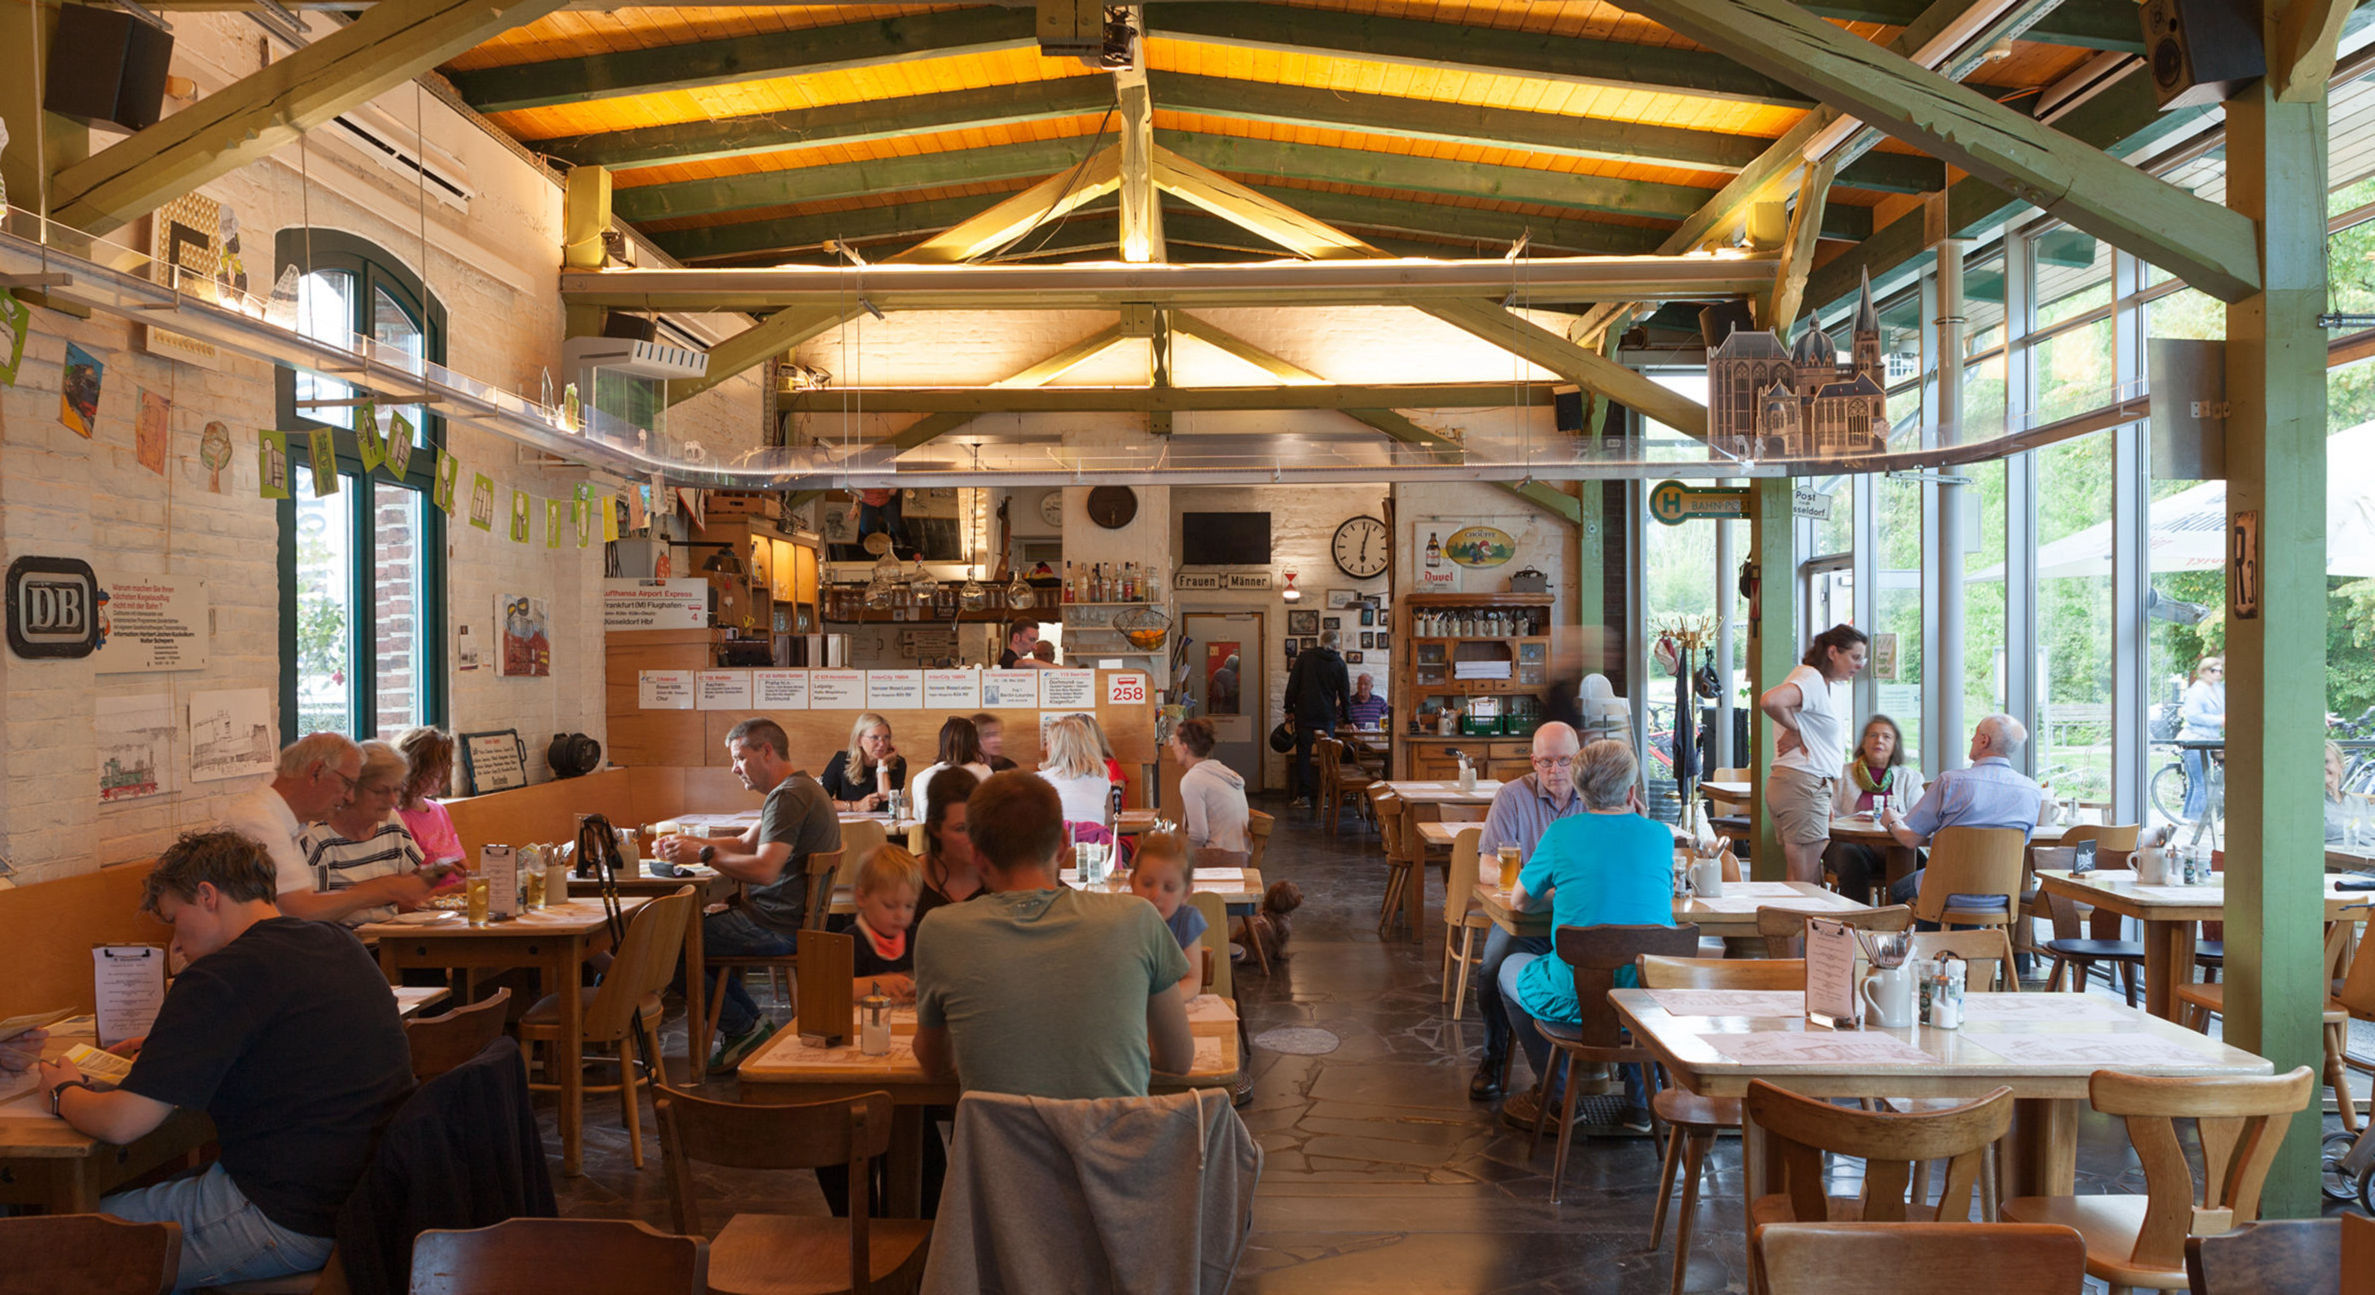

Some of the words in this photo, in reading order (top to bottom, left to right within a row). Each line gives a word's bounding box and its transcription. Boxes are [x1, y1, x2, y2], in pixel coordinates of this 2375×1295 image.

[1796, 491, 1815, 501] Post
[1663, 493, 1680, 513] H
[1793, 506, 1825, 517] sseldorf
[1180, 576, 1215, 586] Frauen
[1231, 576, 1266, 586] Männer
[1424, 571, 1454, 583] Duvel
[639, 590, 662, 598] Airport
[664, 590, 693, 598] Express
[28, 587, 81, 628] DB
[691, 613, 698, 621] 4
[1113, 687, 1144, 701] 258
